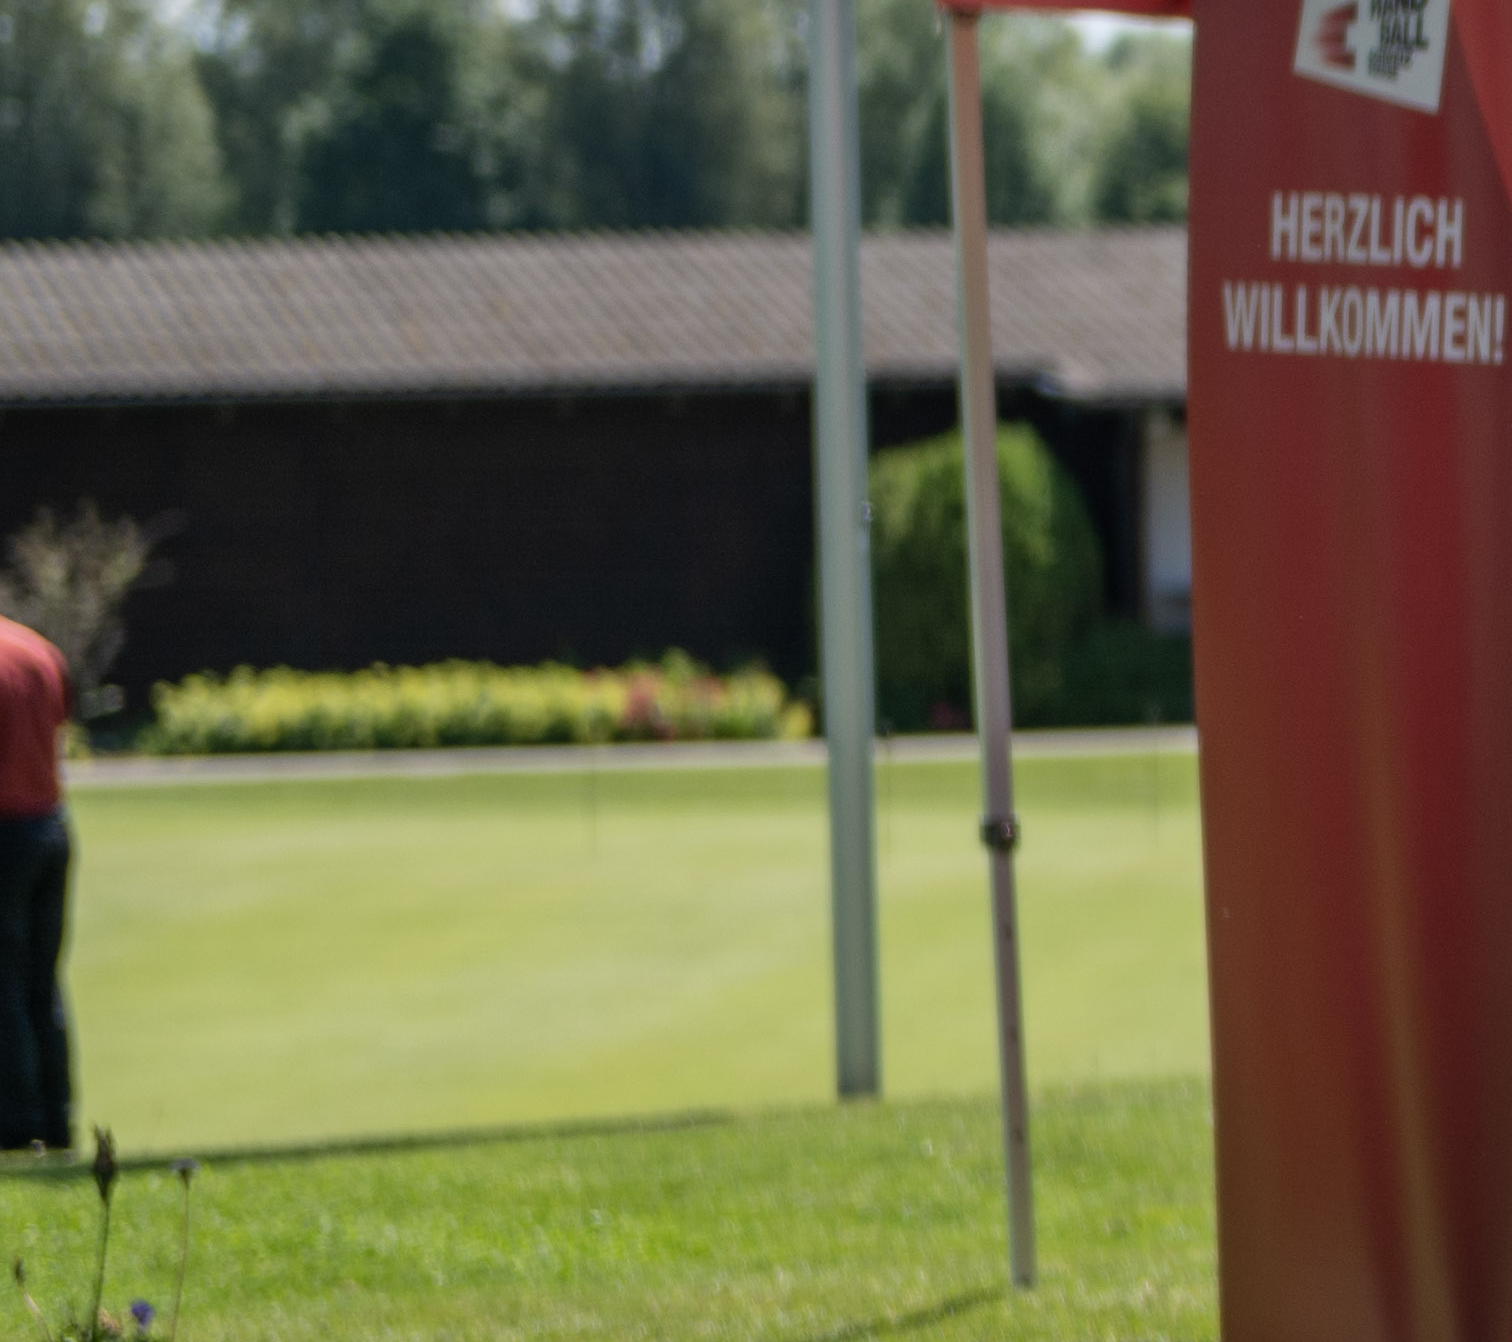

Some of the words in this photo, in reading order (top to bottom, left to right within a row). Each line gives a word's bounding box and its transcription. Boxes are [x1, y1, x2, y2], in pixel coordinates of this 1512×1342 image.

[1380, 11, 1429, 50] BALL
[1271, 190, 1463, 269] HERZLICH
[1222, 279, 1506, 365] WILLKOMMEN!
